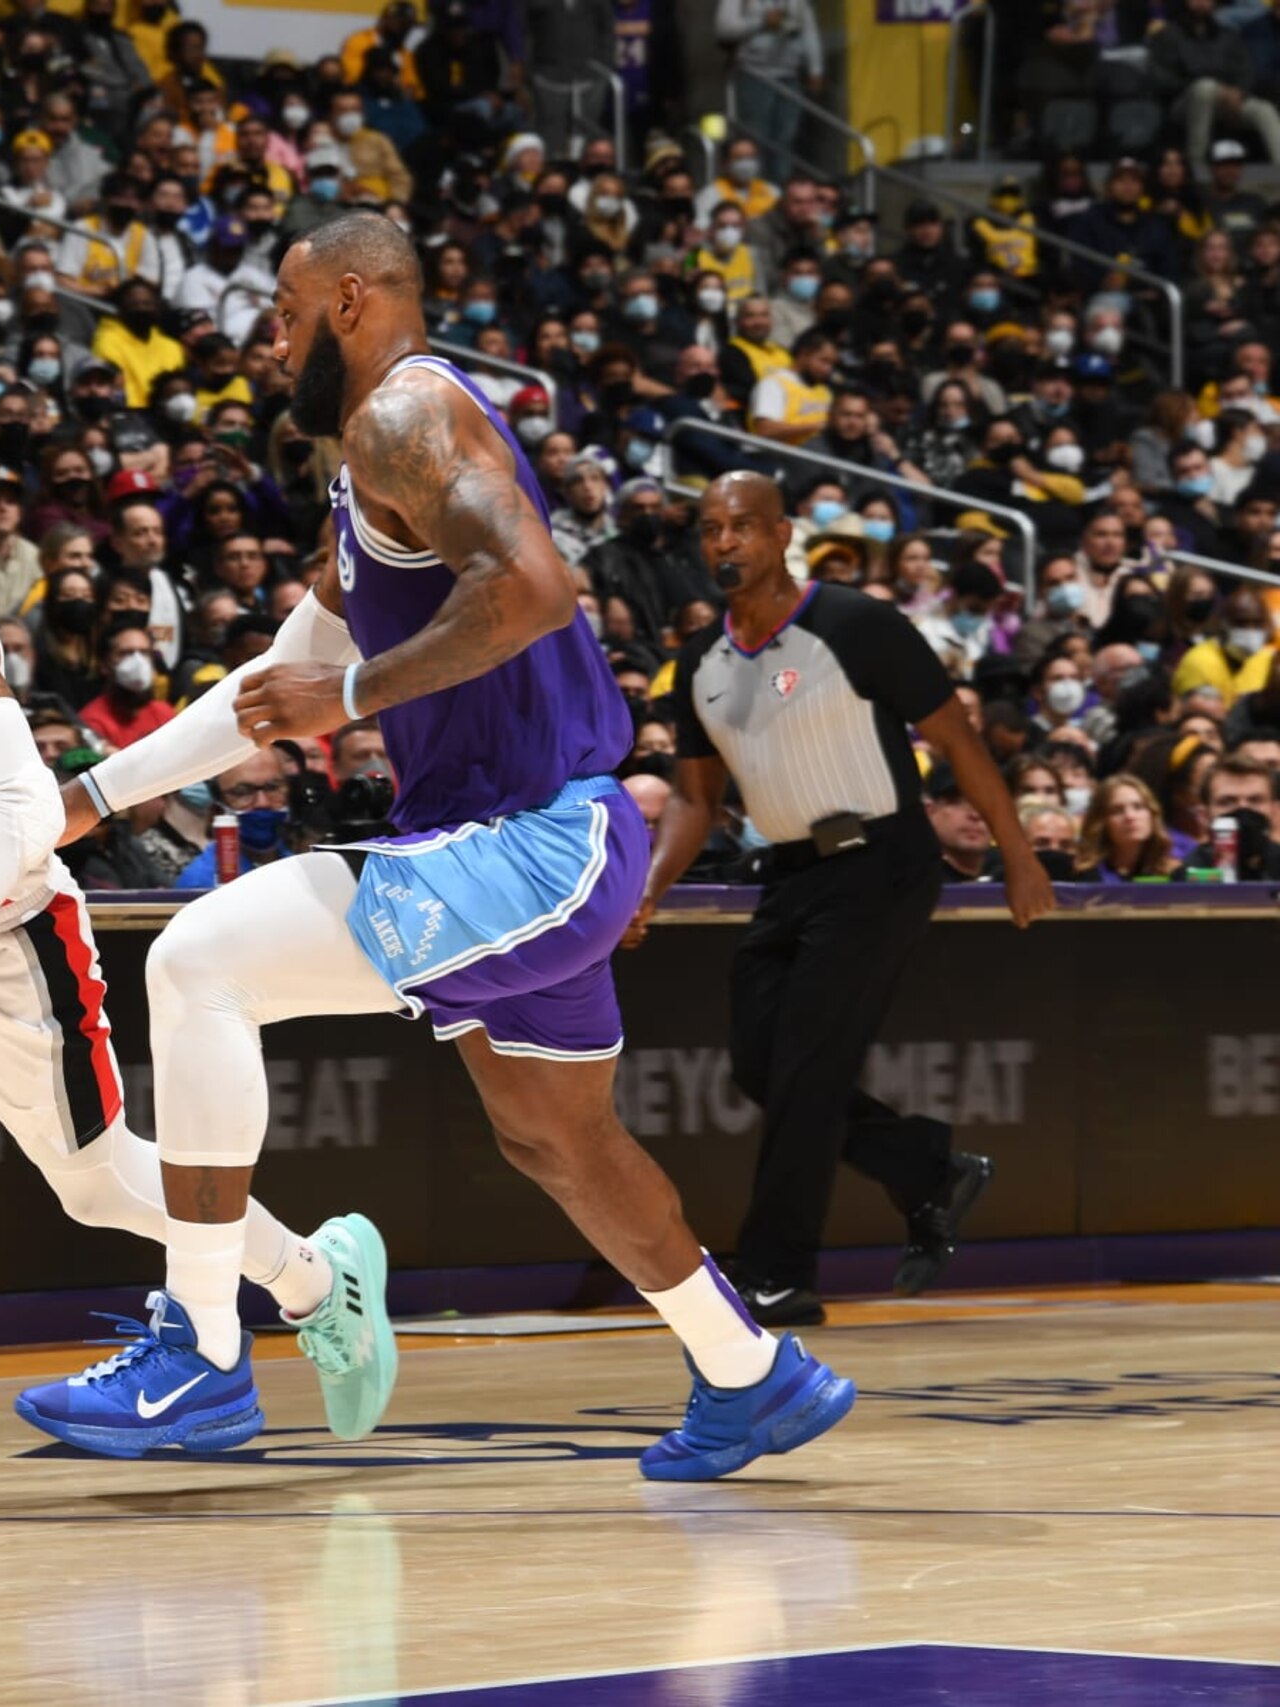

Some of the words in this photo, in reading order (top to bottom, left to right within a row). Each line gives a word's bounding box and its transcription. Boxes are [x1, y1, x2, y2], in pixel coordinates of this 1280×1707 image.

[369, 908, 404, 959] LAKERS
[375, 881, 414, 902] LOS
[410, 899, 445, 966] ANGELES
[265, 1057, 388, 1150] EAT
